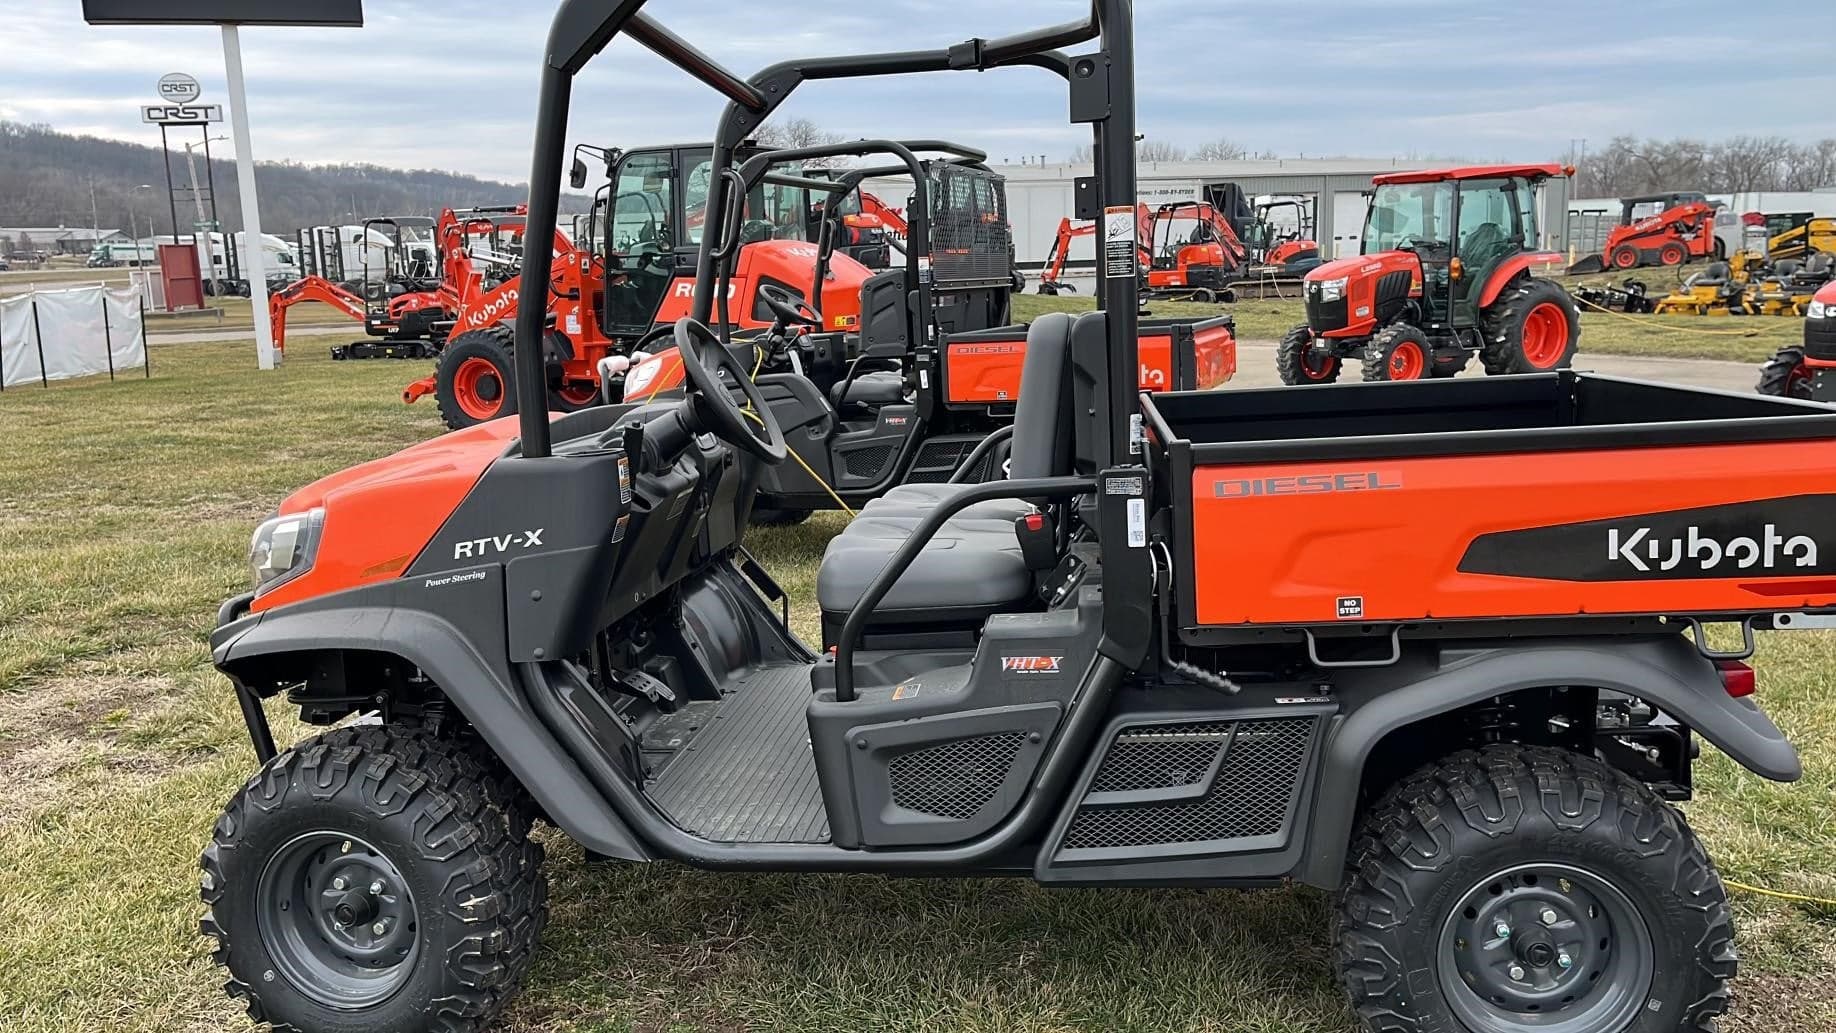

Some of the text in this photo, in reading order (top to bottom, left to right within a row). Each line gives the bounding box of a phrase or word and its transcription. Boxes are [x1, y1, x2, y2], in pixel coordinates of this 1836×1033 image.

[161, 83, 195, 92] CRST
[147, 106, 215, 119] CRST
[467, 289, 519, 327] Kubota
[956, 346, 1018, 354] DIESEL
[1214, 472, 1401, 498] DIESEL
[454, 528, 545, 560] RTV-X
[1608, 524, 1818, 572] Kubota
[425, 571, 487, 588] Power Steering
[1343, 599, 1357, 607] NO
[1339, 607, 1361, 615] STEP
